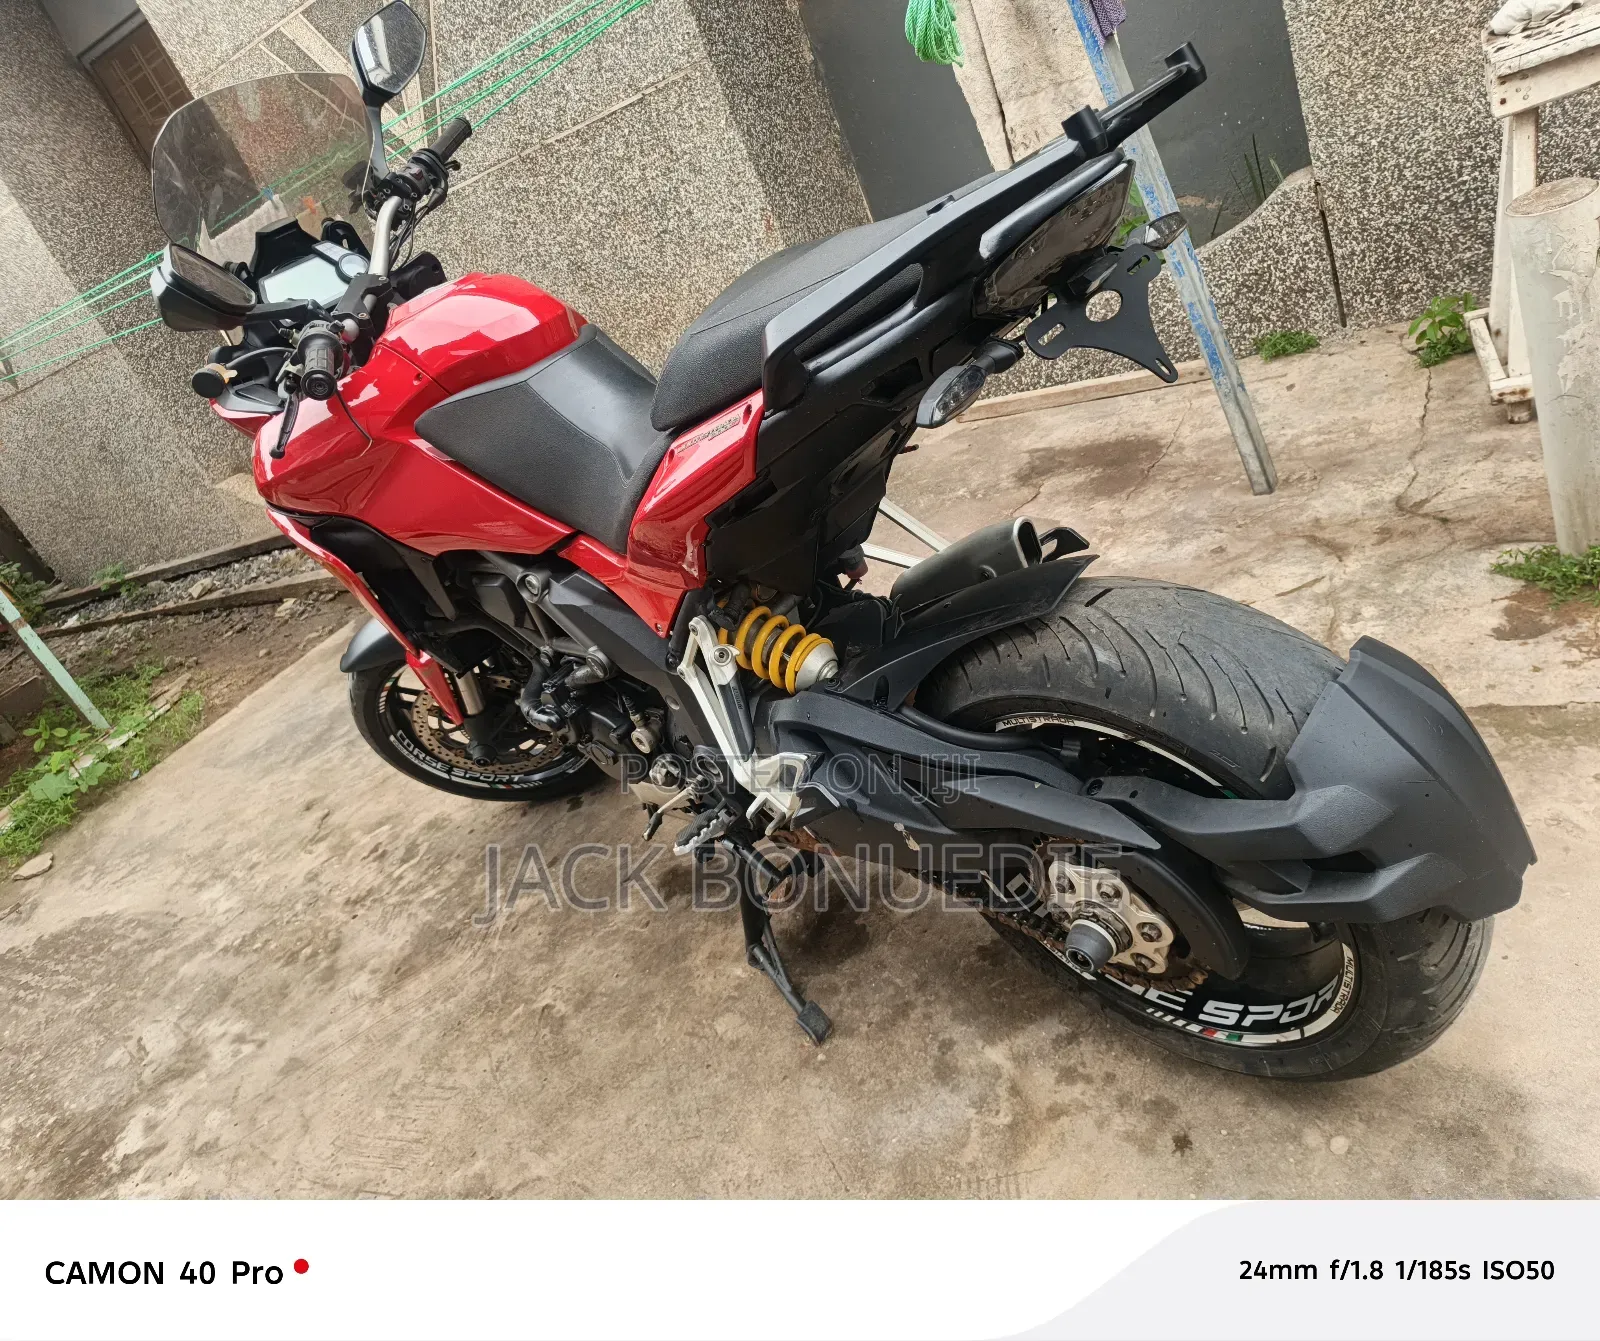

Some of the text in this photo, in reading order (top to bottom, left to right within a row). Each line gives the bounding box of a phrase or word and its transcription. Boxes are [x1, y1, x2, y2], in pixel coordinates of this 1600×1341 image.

[1001, 714, 1076, 727] MULTISTRADA
[396, 729, 452, 773] CORSE
[452, 767, 525, 783] SPORT
[1198, 967, 1343, 1027] SPOR
[1330, 955, 1355, 1015] MULTISTRADA
